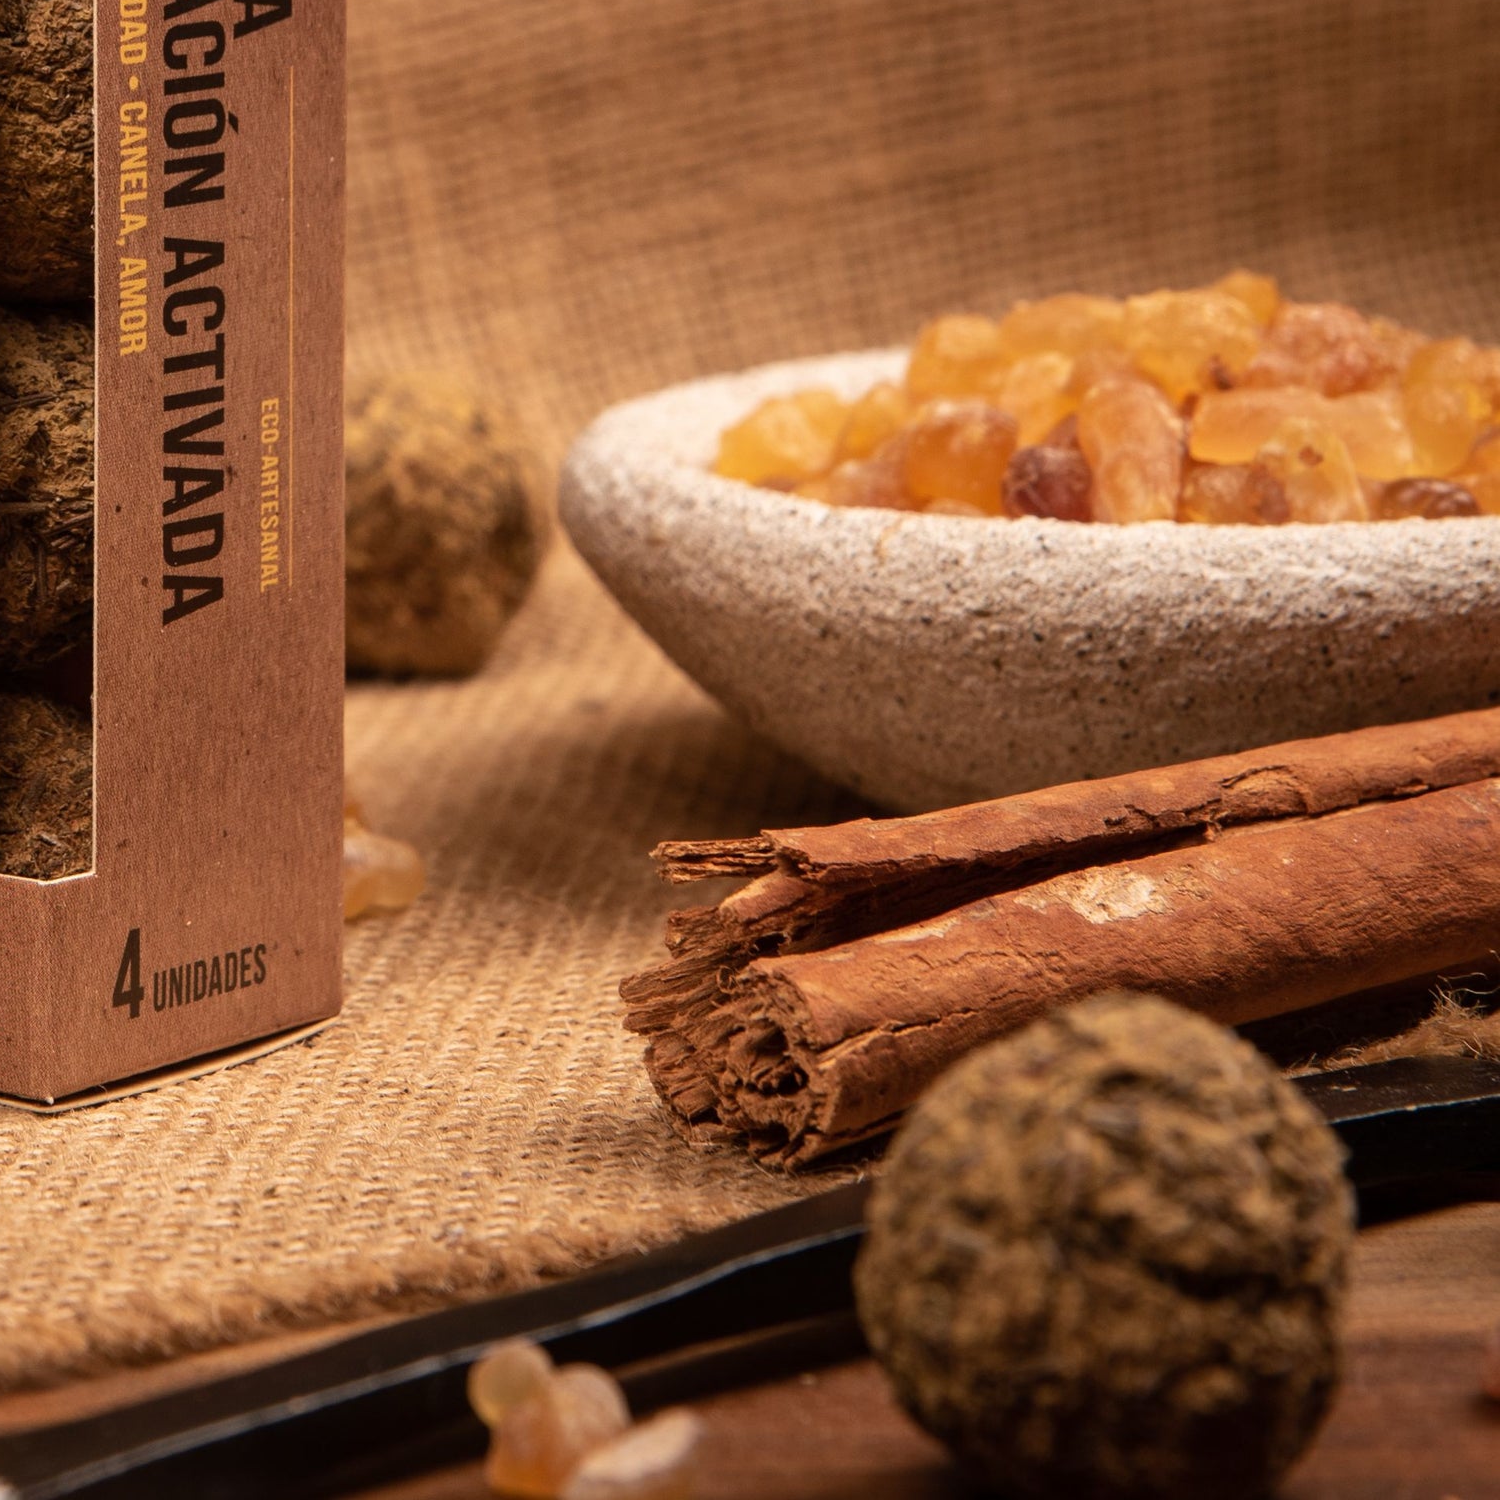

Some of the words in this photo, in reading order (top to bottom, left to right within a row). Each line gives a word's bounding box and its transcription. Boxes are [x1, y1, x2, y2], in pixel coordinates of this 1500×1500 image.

[116, 100, 148, 247] CANELA,
[119, 256, 148, 357] AMOR
[162, 236, 225, 627] ACTIVADA
[260, 397, 280, 593] ECO-ARTESANAL
[112, 928, 145, 1019] 4
[152, 943, 267, 1013] UNIDADES
